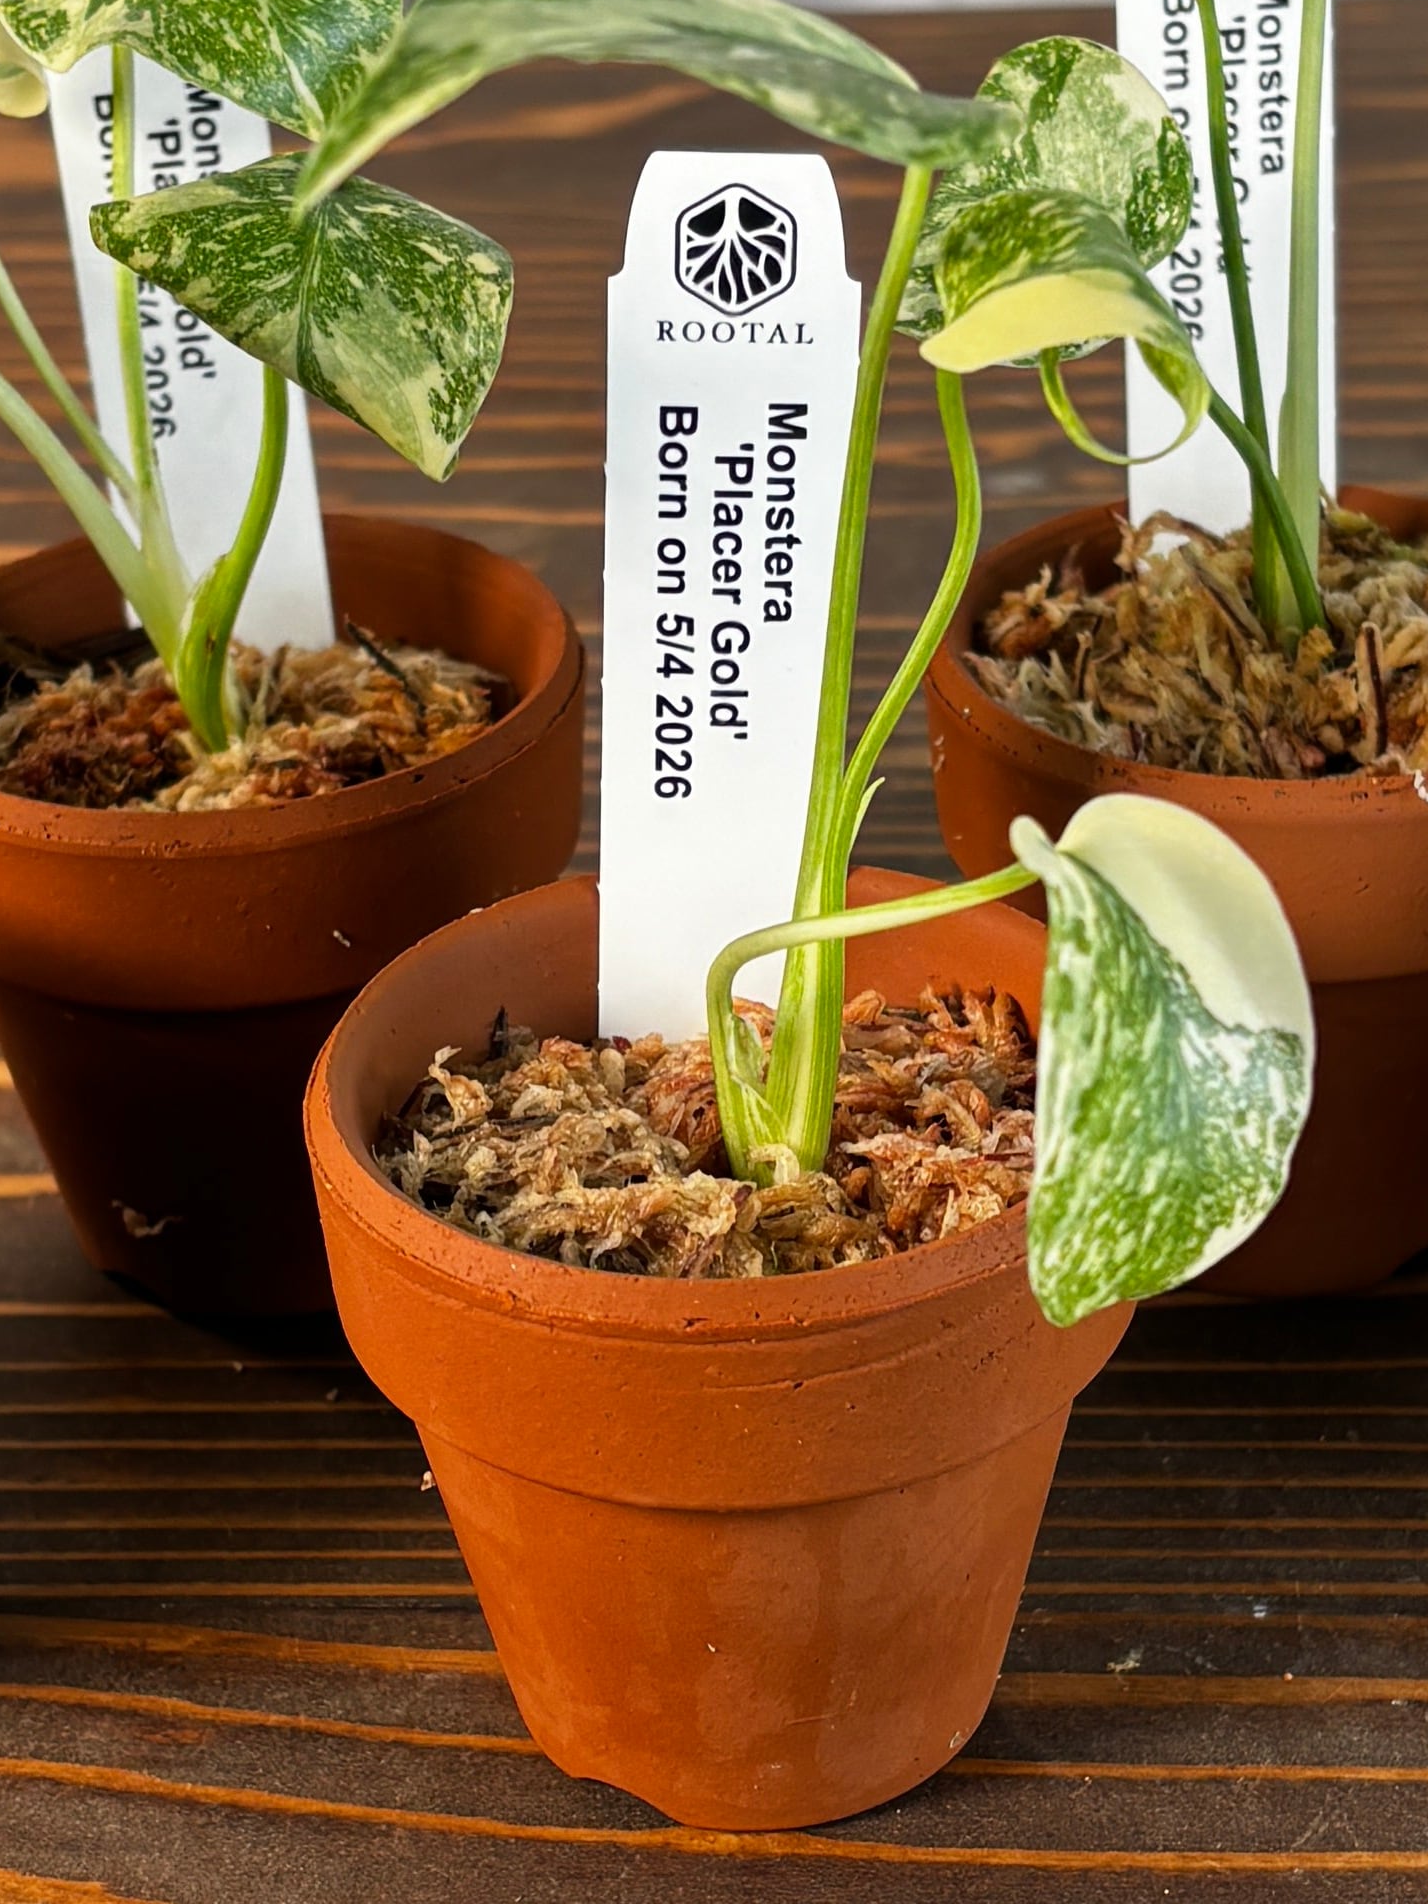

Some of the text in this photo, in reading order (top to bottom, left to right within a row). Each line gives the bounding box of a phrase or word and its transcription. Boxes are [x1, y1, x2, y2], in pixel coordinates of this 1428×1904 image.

[147, 118, 185, 190] 'Pla
[175, 309, 217, 379] old'
[656, 320, 814, 344] ROOTAL
[763, 402, 809, 623] Monstera
[654, 405, 699, 799] Born on 5/4 2026
[709, 442, 755, 739] 'Placer Gold'
